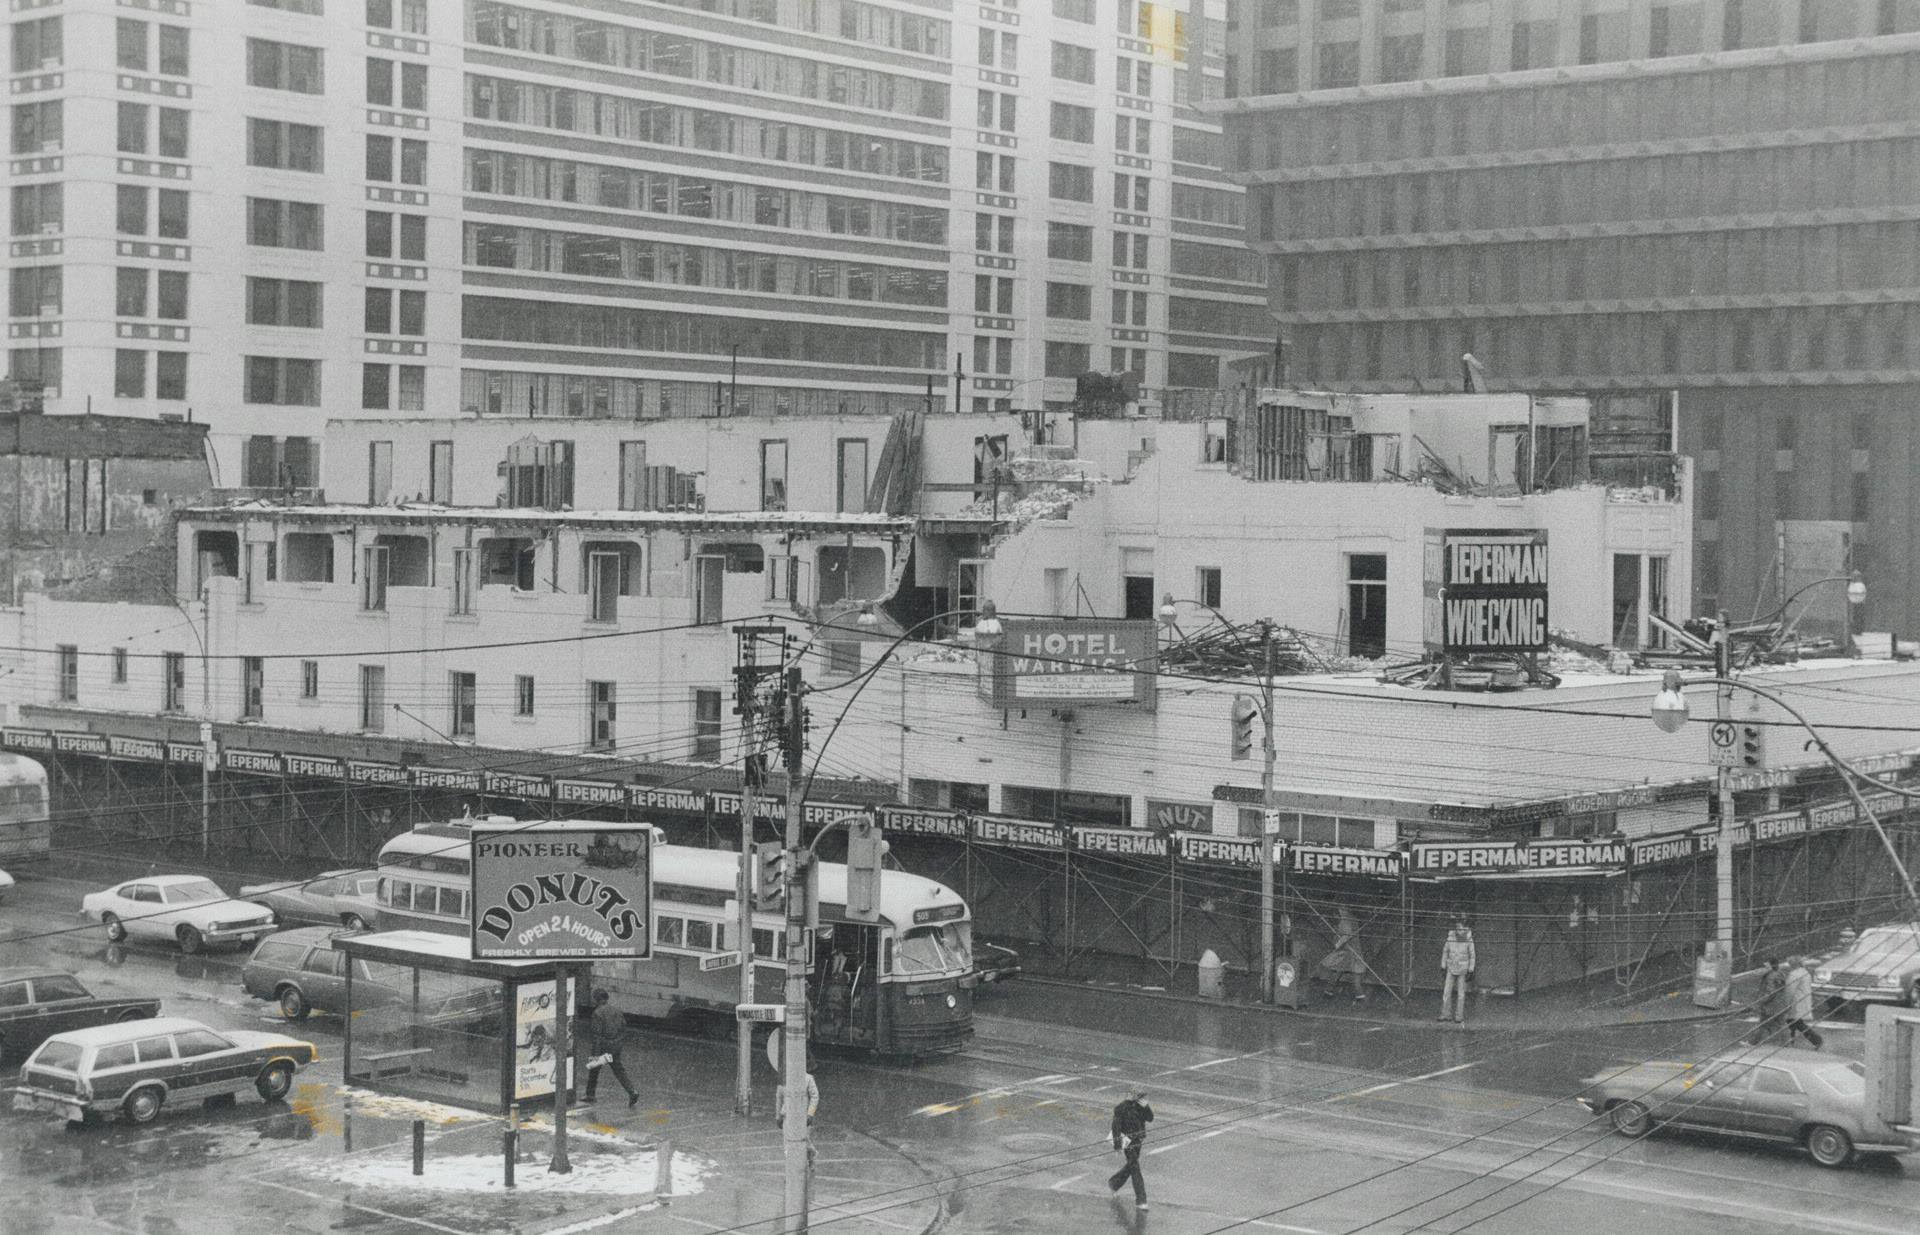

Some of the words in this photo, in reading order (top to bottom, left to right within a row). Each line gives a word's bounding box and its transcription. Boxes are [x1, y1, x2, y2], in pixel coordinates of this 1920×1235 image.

[1445, 536, 1547, 584] TEPERMAN
[1446, 598, 1545, 646] WRECKING
[1023, 633, 1126, 655] HOTEL
[1012, 658, 1138, 674] WARWICK
[2, 729, 52, 749] TEPERMAN
[54, 732, 107, 753] TEPERMAN
[225, 749, 281, 771] TEPERMAN
[284, 754, 344, 777] TEPERMAN
[348, 761, 408, 783] TEPERMAN
[408, 766, 480, 790] TEPERMAN
[485, 771, 551, 797] TEPERMAN
[555, 780, 625, 803] TEPERMAN
[629, 785, 705, 811] TEPERMAN
[882, 809, 965, 836] TEPERMAN
[1157, 805, 1206, 829] NUT
[1753, 811, 1806, 840] TEPERMAN
[1810, 800, 1856, 829] TEPERMAN
[973, 815, 1063, 846] TEPERMAN
[1073, 828, 1167, 856] TEPERMAN
[478, 843, 586, 858] PIONEER
[1290, 845, 1400, 875] TEPERMAN
[1412, 842, 1528, 869] TEPERMAN
[1632, 834, 1692, 866] TEPERMAN
[477, 871, 645, 944] DONUTS
[518, 922, 551, 946] OPEN
[551, 915, 570, 932] 24
[570, 920, 611, 948] HOURS
[481, 948, 533, 957] FRESHLY
[535, 947, 586, 957] BREWED
[591, 947, 636, 956] COFFEE
